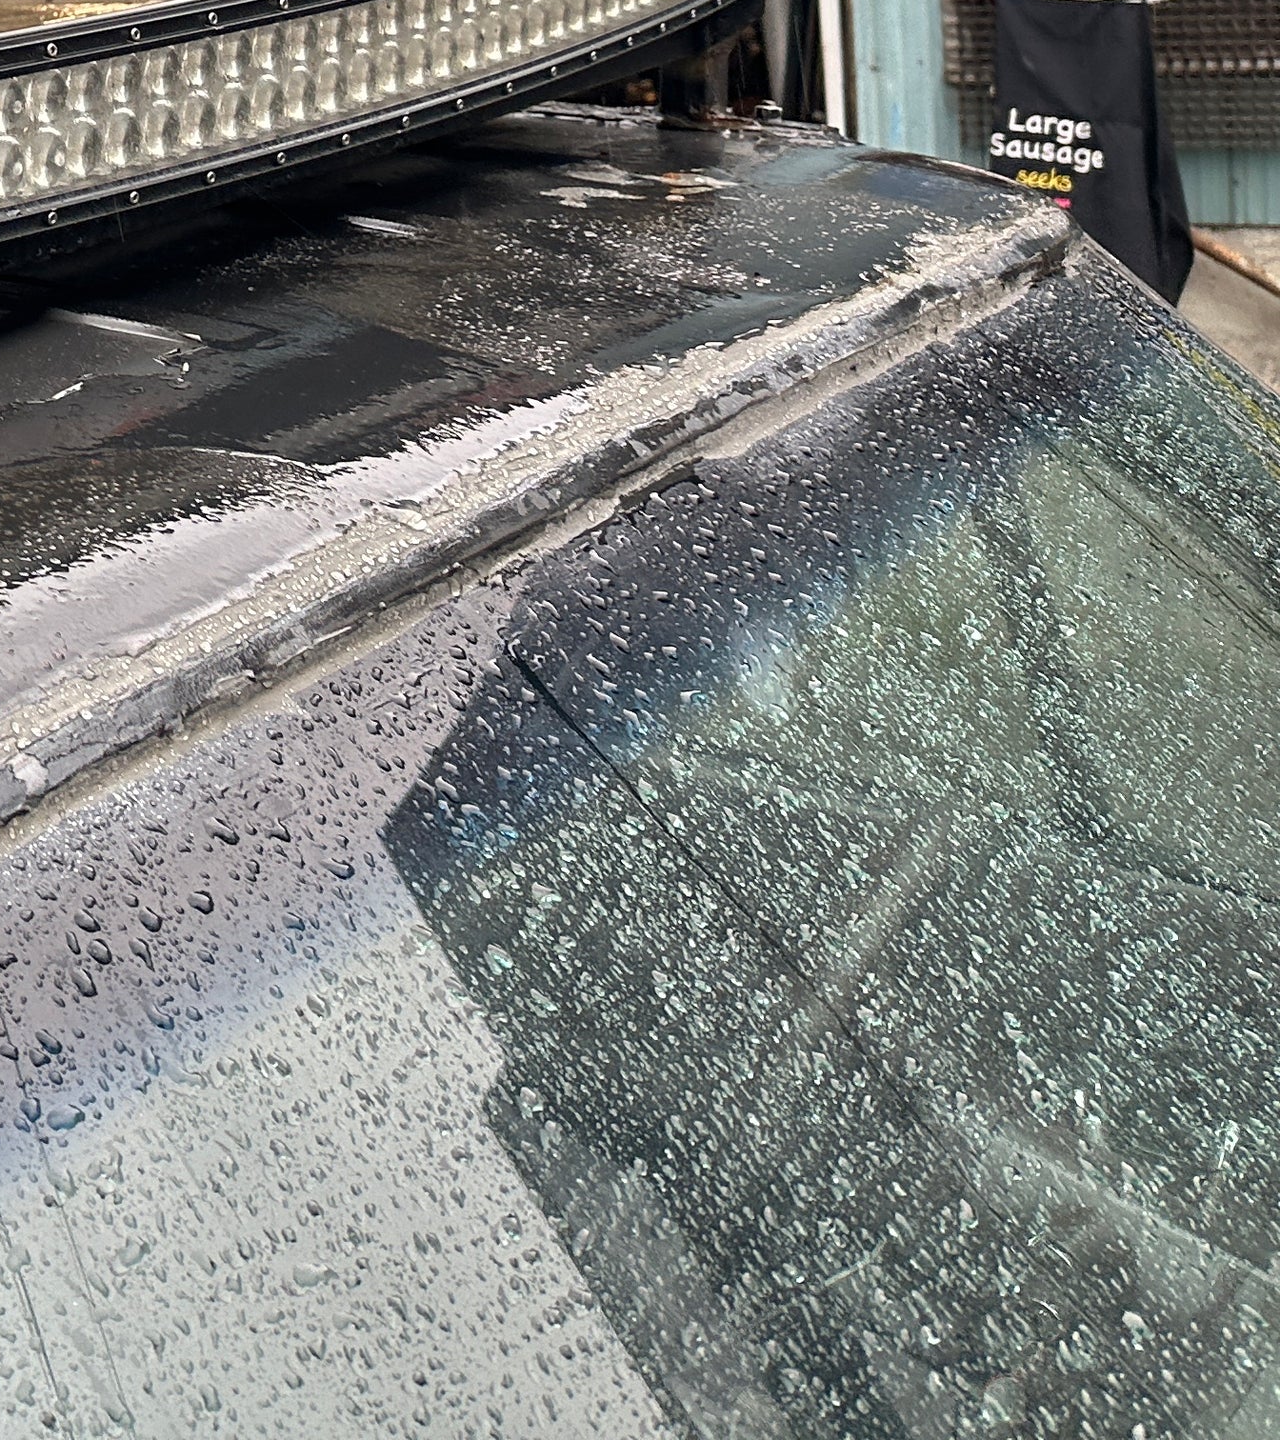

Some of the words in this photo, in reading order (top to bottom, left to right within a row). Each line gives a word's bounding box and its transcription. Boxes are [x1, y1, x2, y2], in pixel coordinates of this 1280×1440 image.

[1008, 107, 1092, 145] Large
[989, 132, 1104, 174] Sausage
[1016, 167, 1072, 192] seeks
